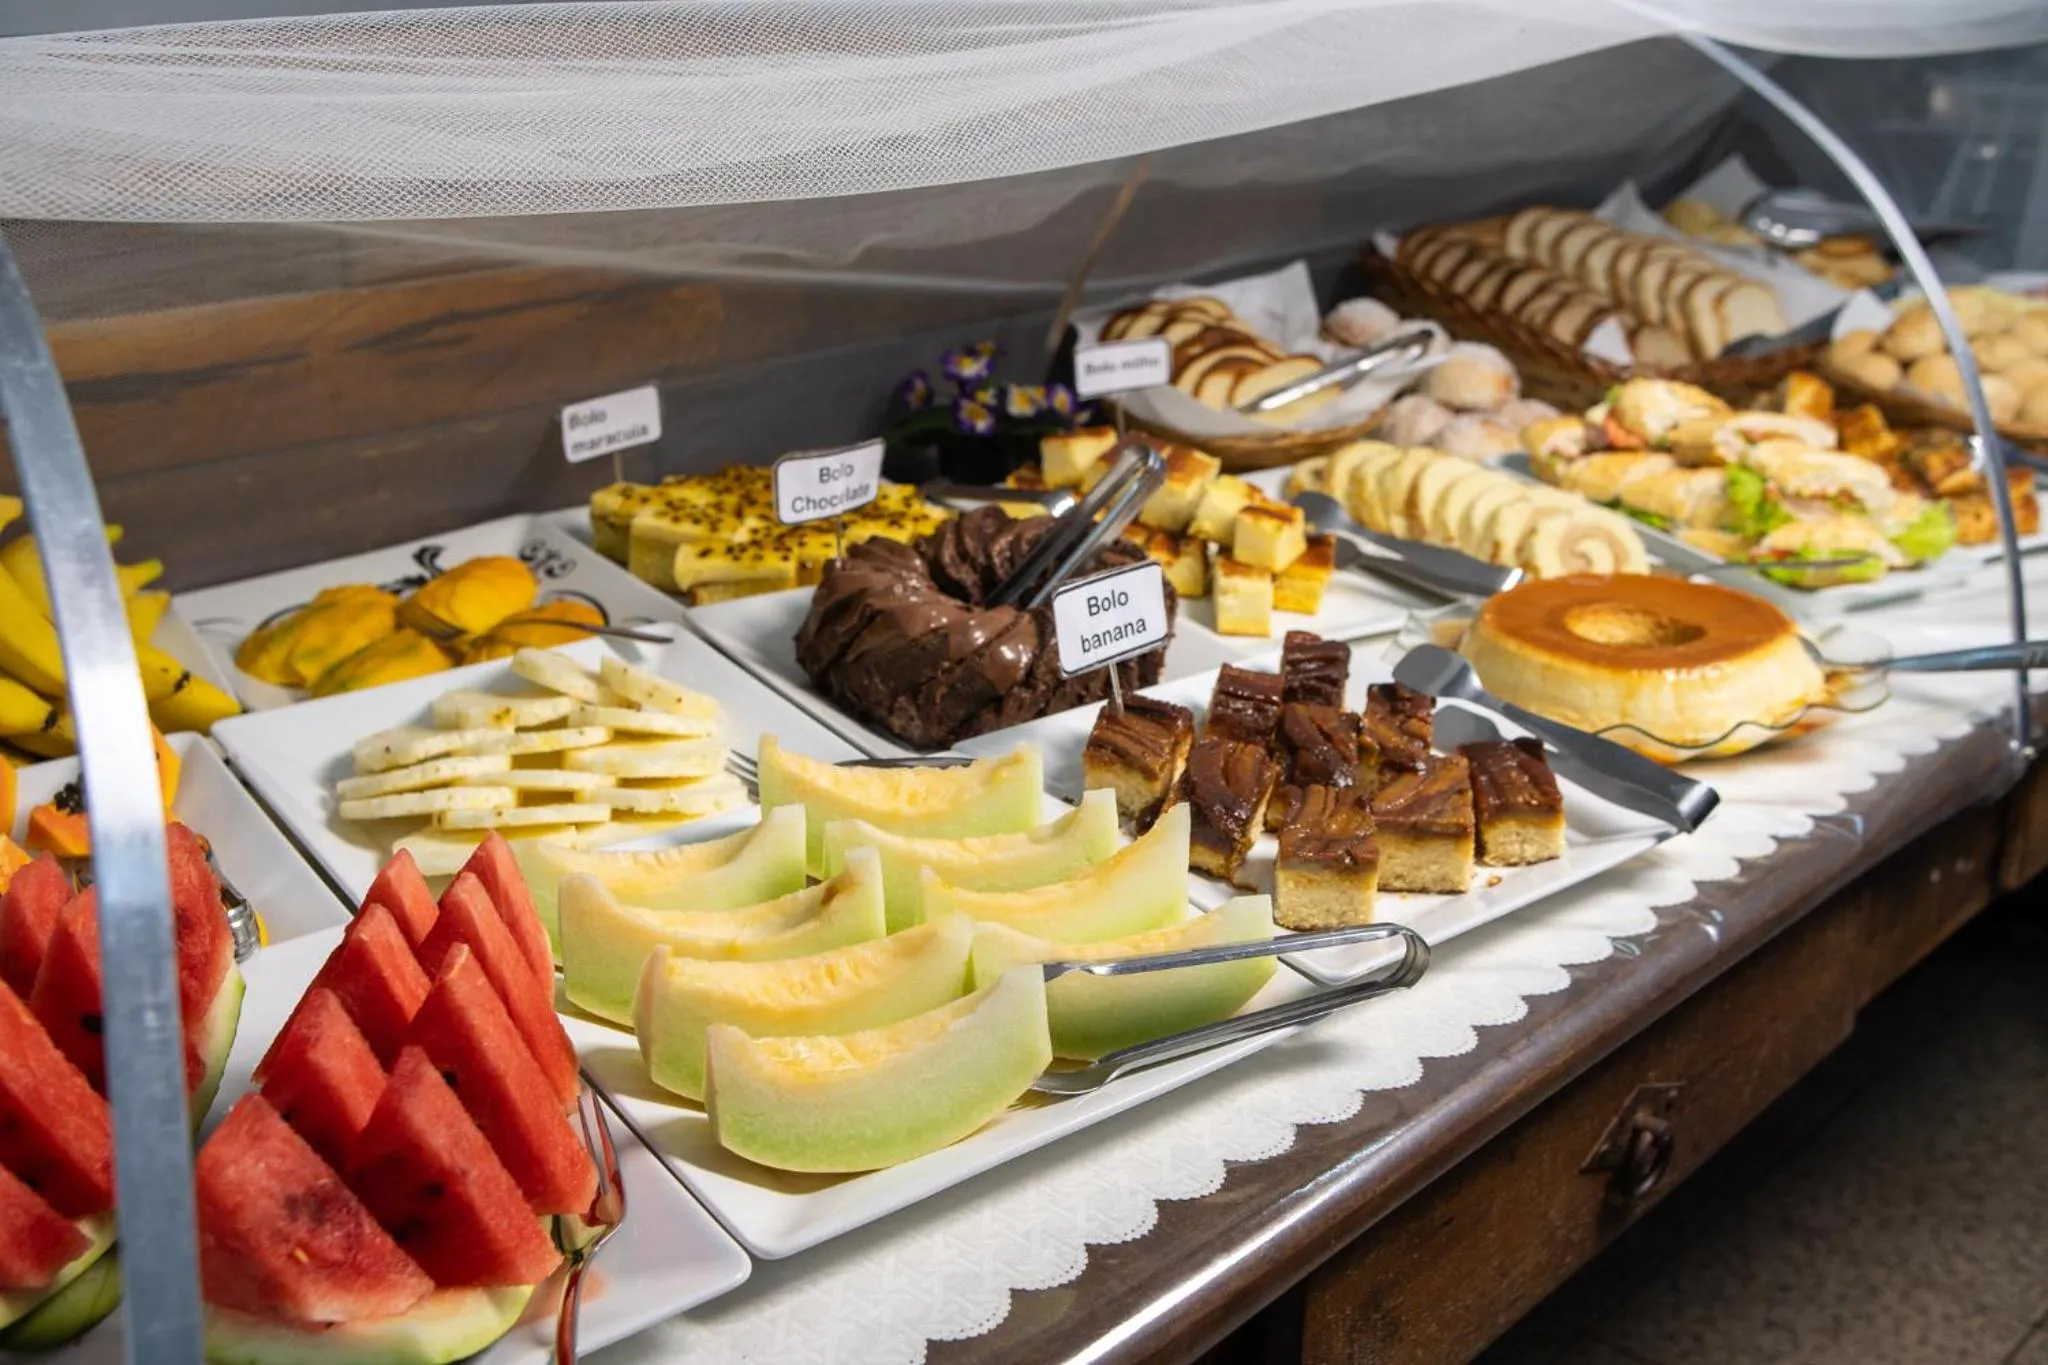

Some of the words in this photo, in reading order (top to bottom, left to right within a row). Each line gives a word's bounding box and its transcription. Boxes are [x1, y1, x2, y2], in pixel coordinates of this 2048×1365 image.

[569, 409, 607, 430] Bolo
[818, 463, 855, 484] Bolo
[1086, 589, 1129, 617] Bolo
[1080, 618, 1147, 654] banana
